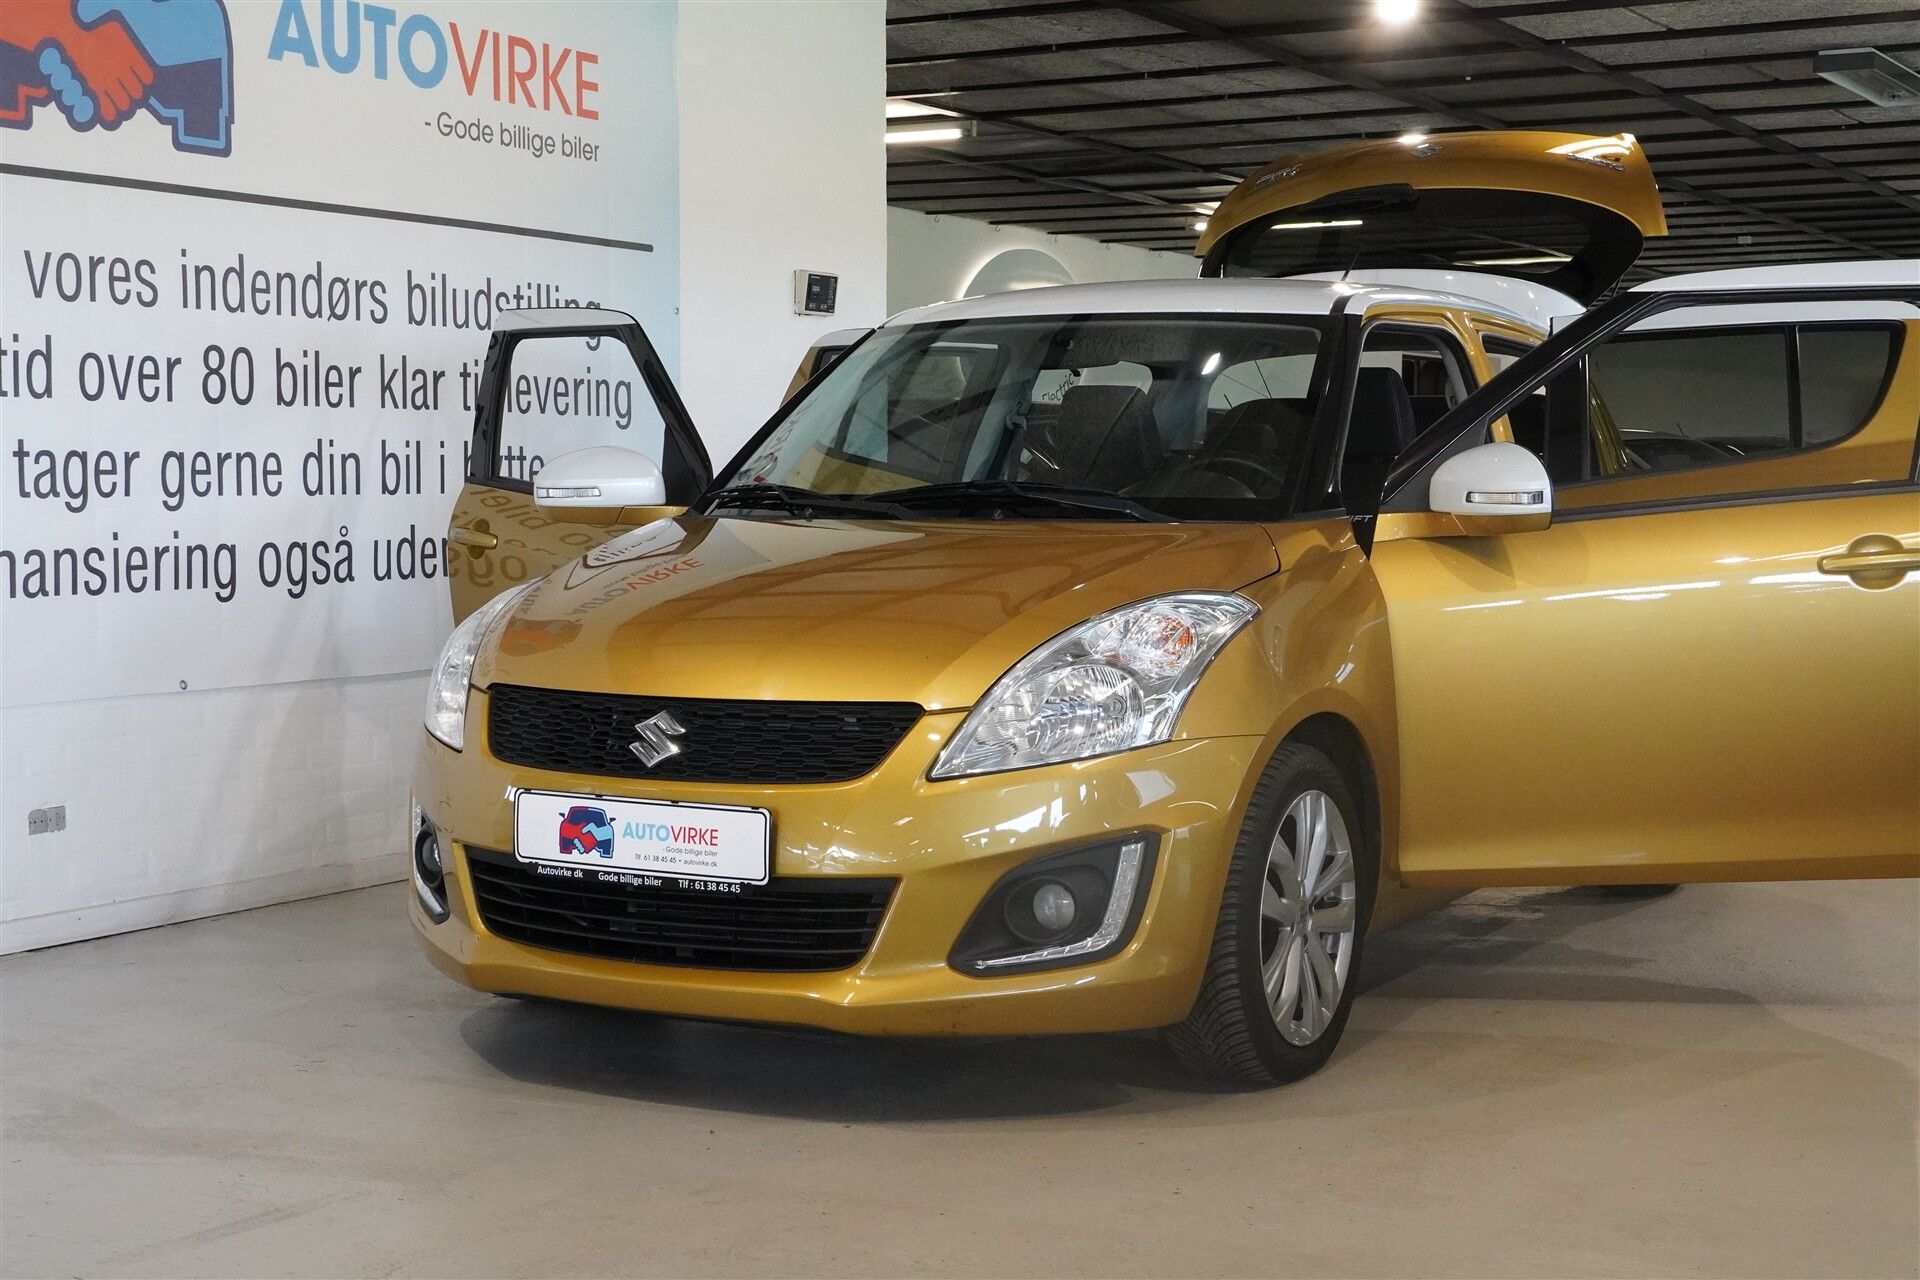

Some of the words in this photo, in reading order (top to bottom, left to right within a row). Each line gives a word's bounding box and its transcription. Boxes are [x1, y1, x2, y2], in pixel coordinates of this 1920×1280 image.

[267, 0, 600, 121] AUTOVIRKE
[437, 112, 494, 143] Gode
[499, 122, 556, 159] billige
[561, 134, 600, 162] biler
[24, 249, 159, 307] vores
[181, 249, 388, 324] indendørs
[78, 352, 182, 403] over
[201, 344, 255, 406] 80
[275, 347, 362, 409] biler
[379, 353, 446, 411] klar
[459, 358, 480, 412] ti
[505, 365, 632, 430] levering
[12, 438, 141, 513] tager
[160, 450, 283, 512] gerne
[302, 438, 361, 496] din
[381, 439, 422, 496] bil
[439, 440, 446, 495] i
[258, 525, 356, 600] også
[622, 821, 719, 847] AUTOVIRKE
[665, 846, 683, 854] Gode
[684, 847, 704, 857] billige
[704, 849, 718, 857] biler
[537, 865, 572, 877] Autovirke
[574, 869, 583, 878] dk
[669, 856, 677, 864] 45
[598, 872, 618, 882] Gode
[620, 875, 643, 886] billige
[644, 876, 663, 887] biler
[695, 881, 705, 890] 61
[706, 882, 717, 891] 38
[718, 883, 728, 892] 45
[730, 884, 741, 893] 45
